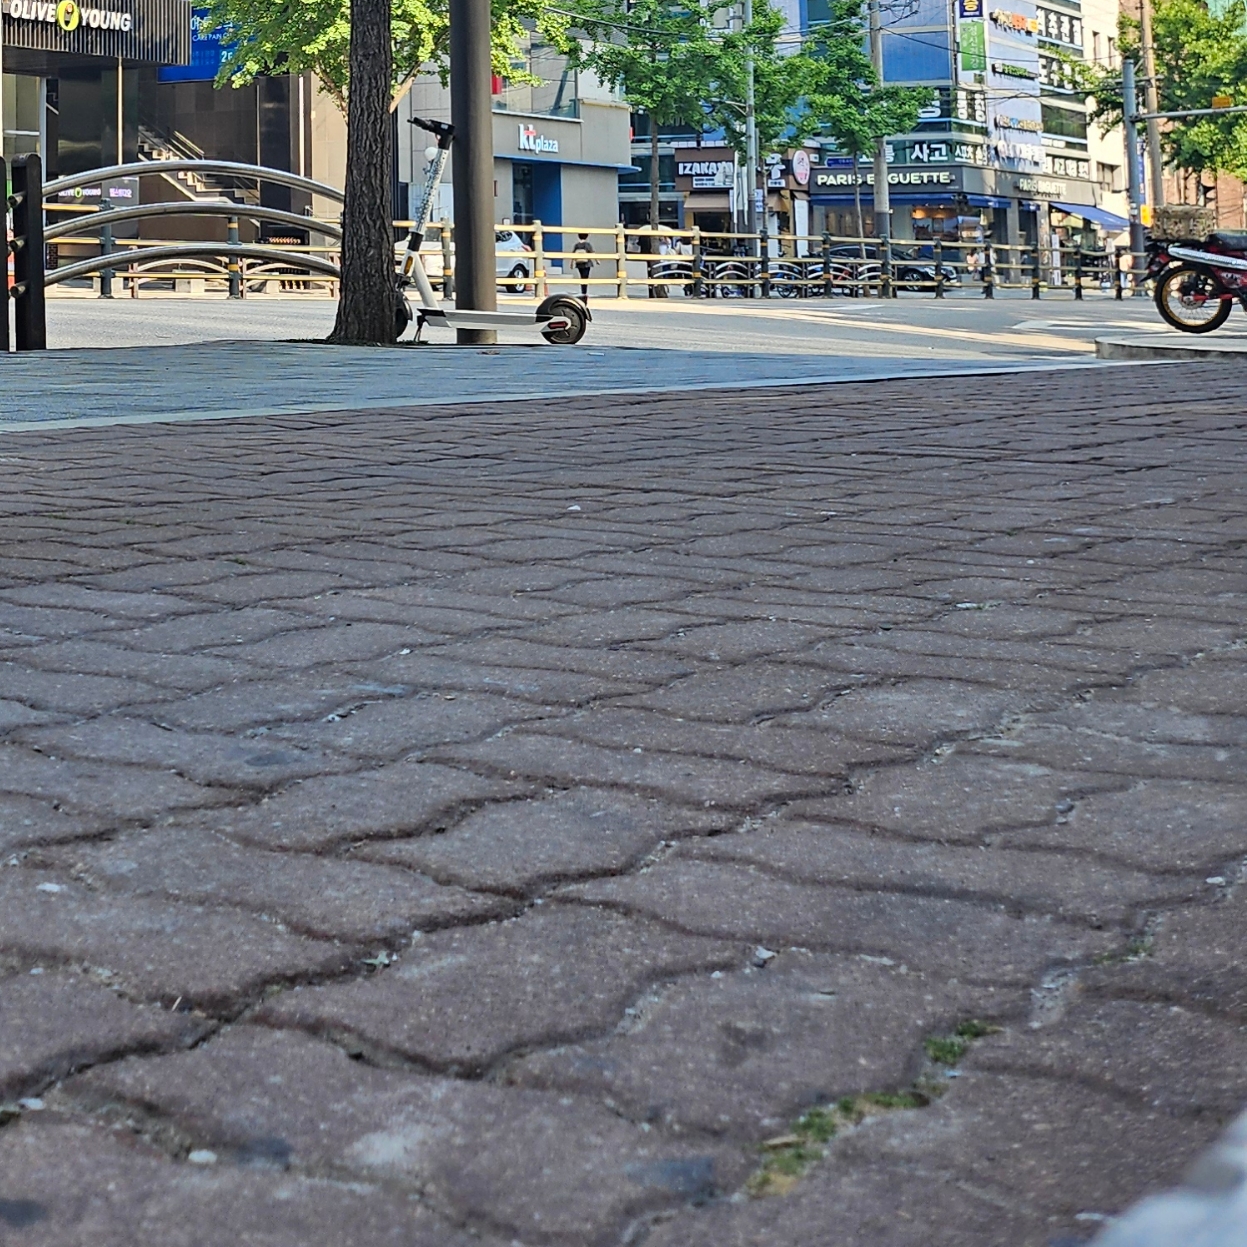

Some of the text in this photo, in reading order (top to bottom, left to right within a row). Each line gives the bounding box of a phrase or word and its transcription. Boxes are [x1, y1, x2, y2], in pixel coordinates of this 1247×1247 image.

[10, 0, 132, 32] OLIVE YOUNG
[518, 124, 559, 154] kt plaza
[911, 143, 948, 163] 사고
[817, 171, 951, 186] PARIS BGUETTE
[1019, 178, 1037, 192] PARIS
